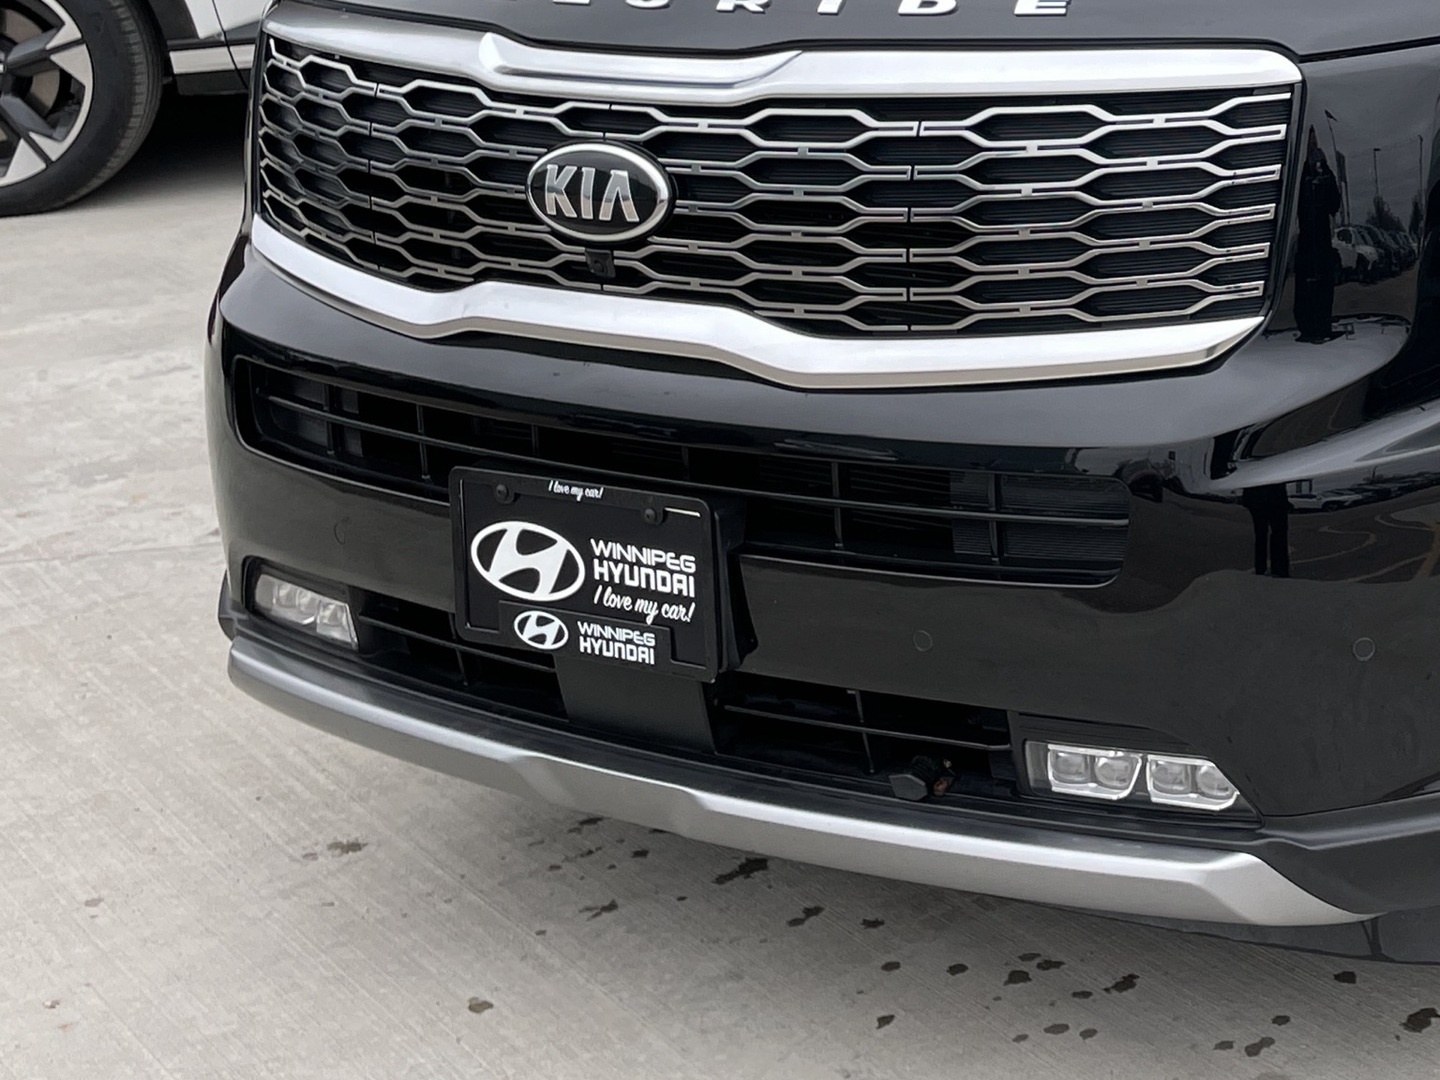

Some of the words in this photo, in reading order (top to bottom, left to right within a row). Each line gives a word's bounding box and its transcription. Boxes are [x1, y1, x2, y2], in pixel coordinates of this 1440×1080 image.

[544, 164, 640, 223] KIA
[554, 480, 571, 495] love
[570, 486, 584, 501] my
[585, 487, 604, 499] car!
[590, 538, 696, 573] WINNIPEG
[594, 558, 695, 598] HYUNDAI
[594, 585, 603, 604] I
[603, 586, 632, 611] love
[635, 598, 659, 625] my
[661, 602, 696, 623] car!
[578, 621, 656, 647] WINNIPEG
[579, 635, 655, 665] HYUNDAI
